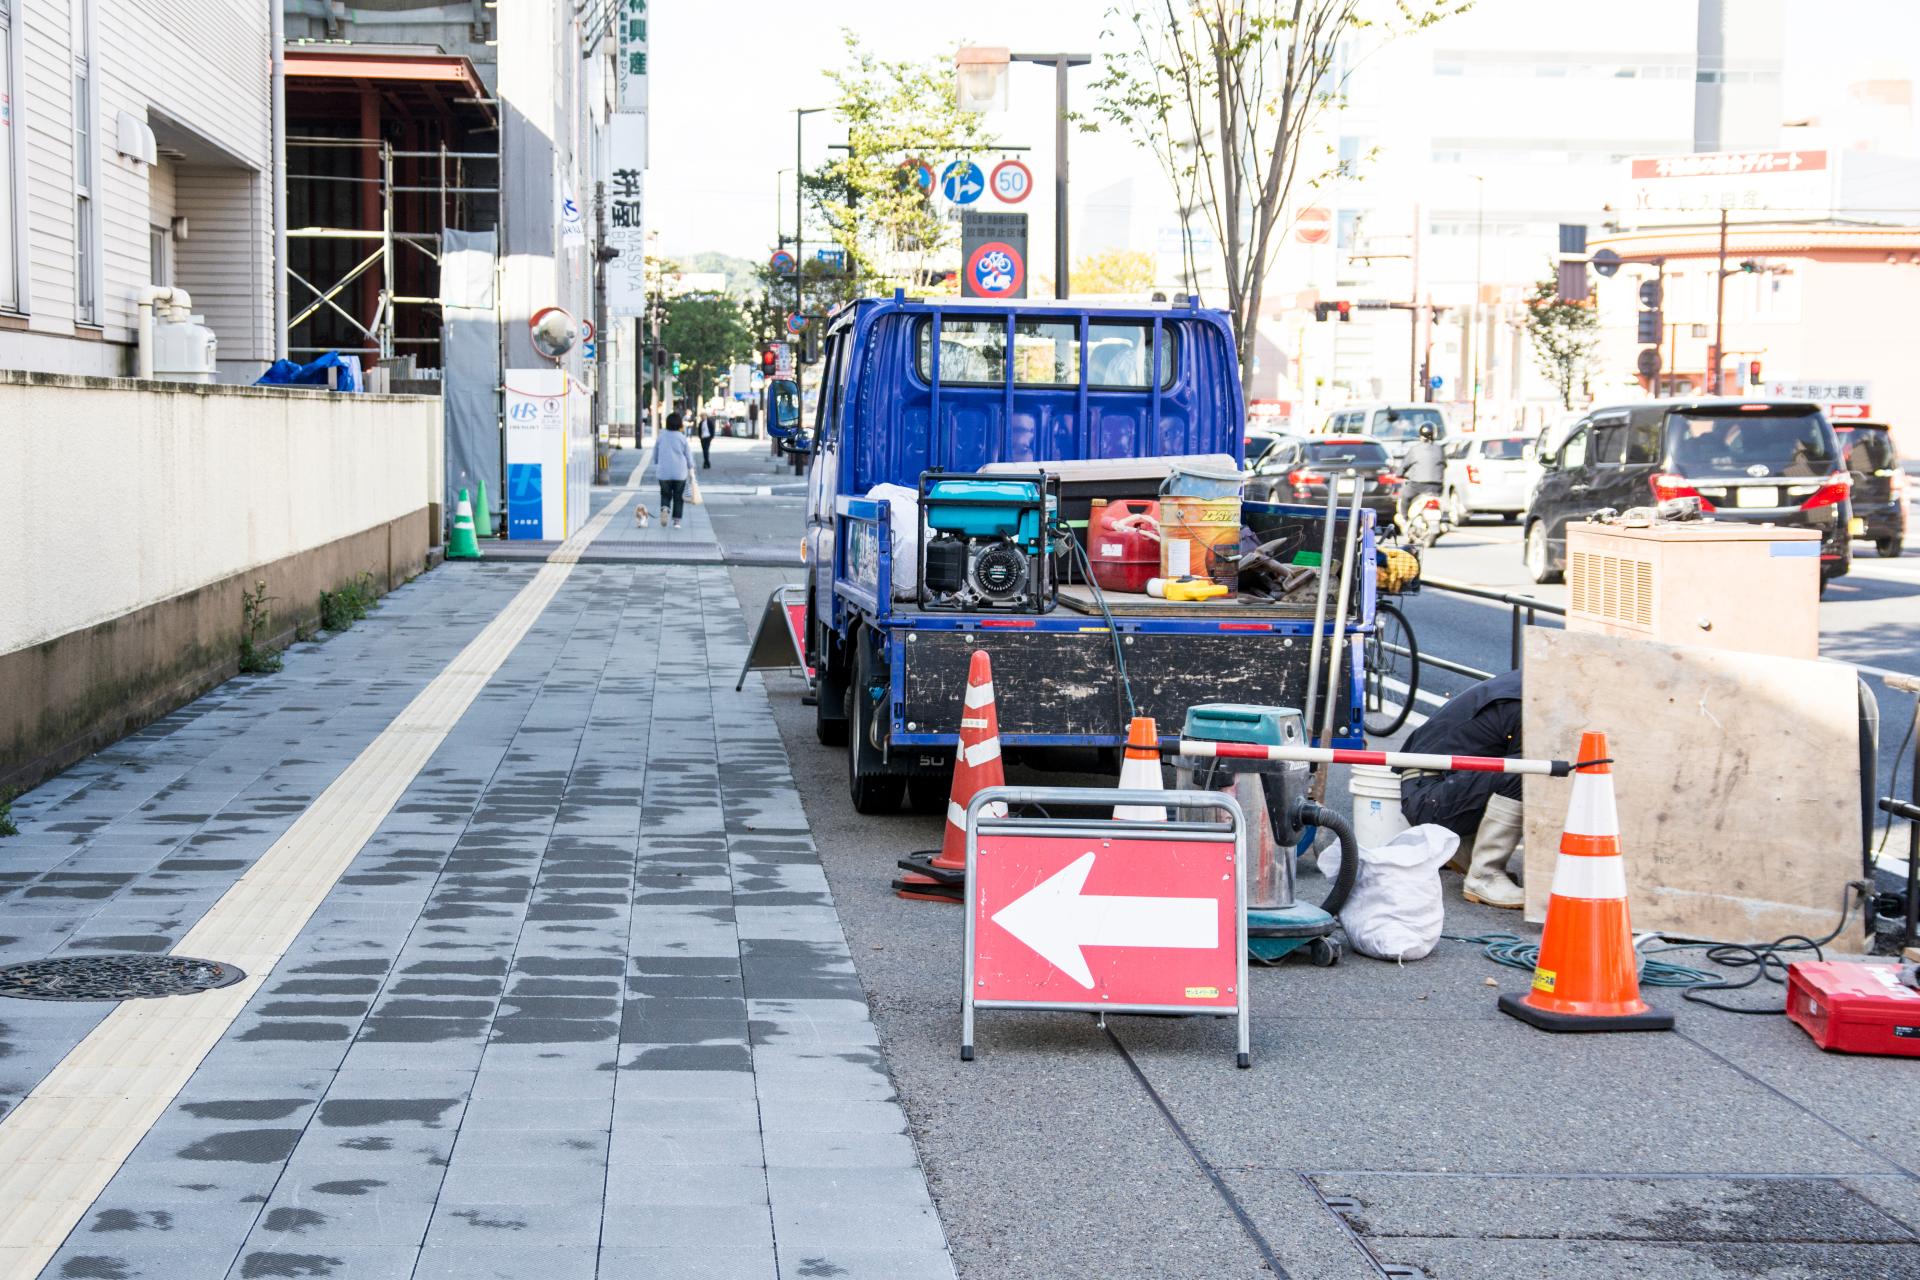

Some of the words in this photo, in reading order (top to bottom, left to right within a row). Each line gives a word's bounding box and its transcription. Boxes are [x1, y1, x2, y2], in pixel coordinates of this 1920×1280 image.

[612, 168, 641, 227] 枡屋
[1000, 172, 1023, 191] 50
[627, 231, 641, 292] MASUYA
